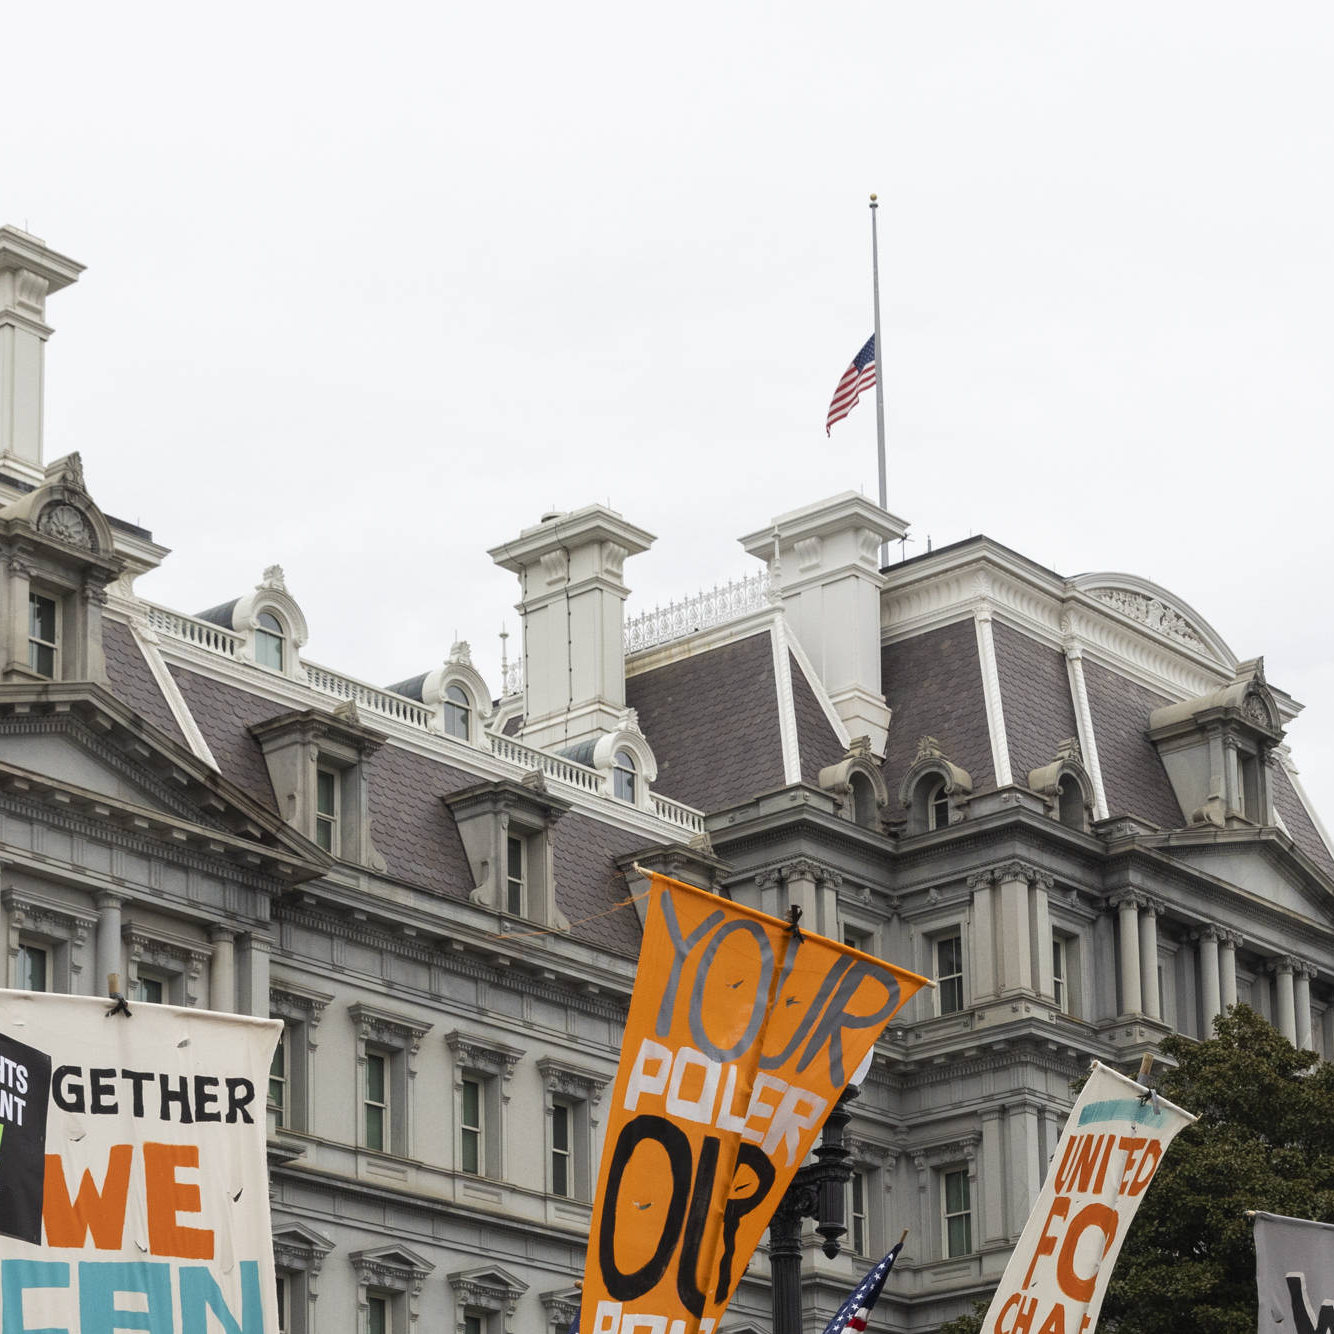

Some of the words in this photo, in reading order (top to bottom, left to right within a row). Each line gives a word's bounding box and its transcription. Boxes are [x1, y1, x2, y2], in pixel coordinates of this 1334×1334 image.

[657, 890, 900, 1089] YOUR
[51, 1066, 255, 1125] GETHER
[42, 1142, 215, 1260] WE
[1054, 1133, 1162, 1197] UNITED
[1021, 1195, 1119, 1304] FO
